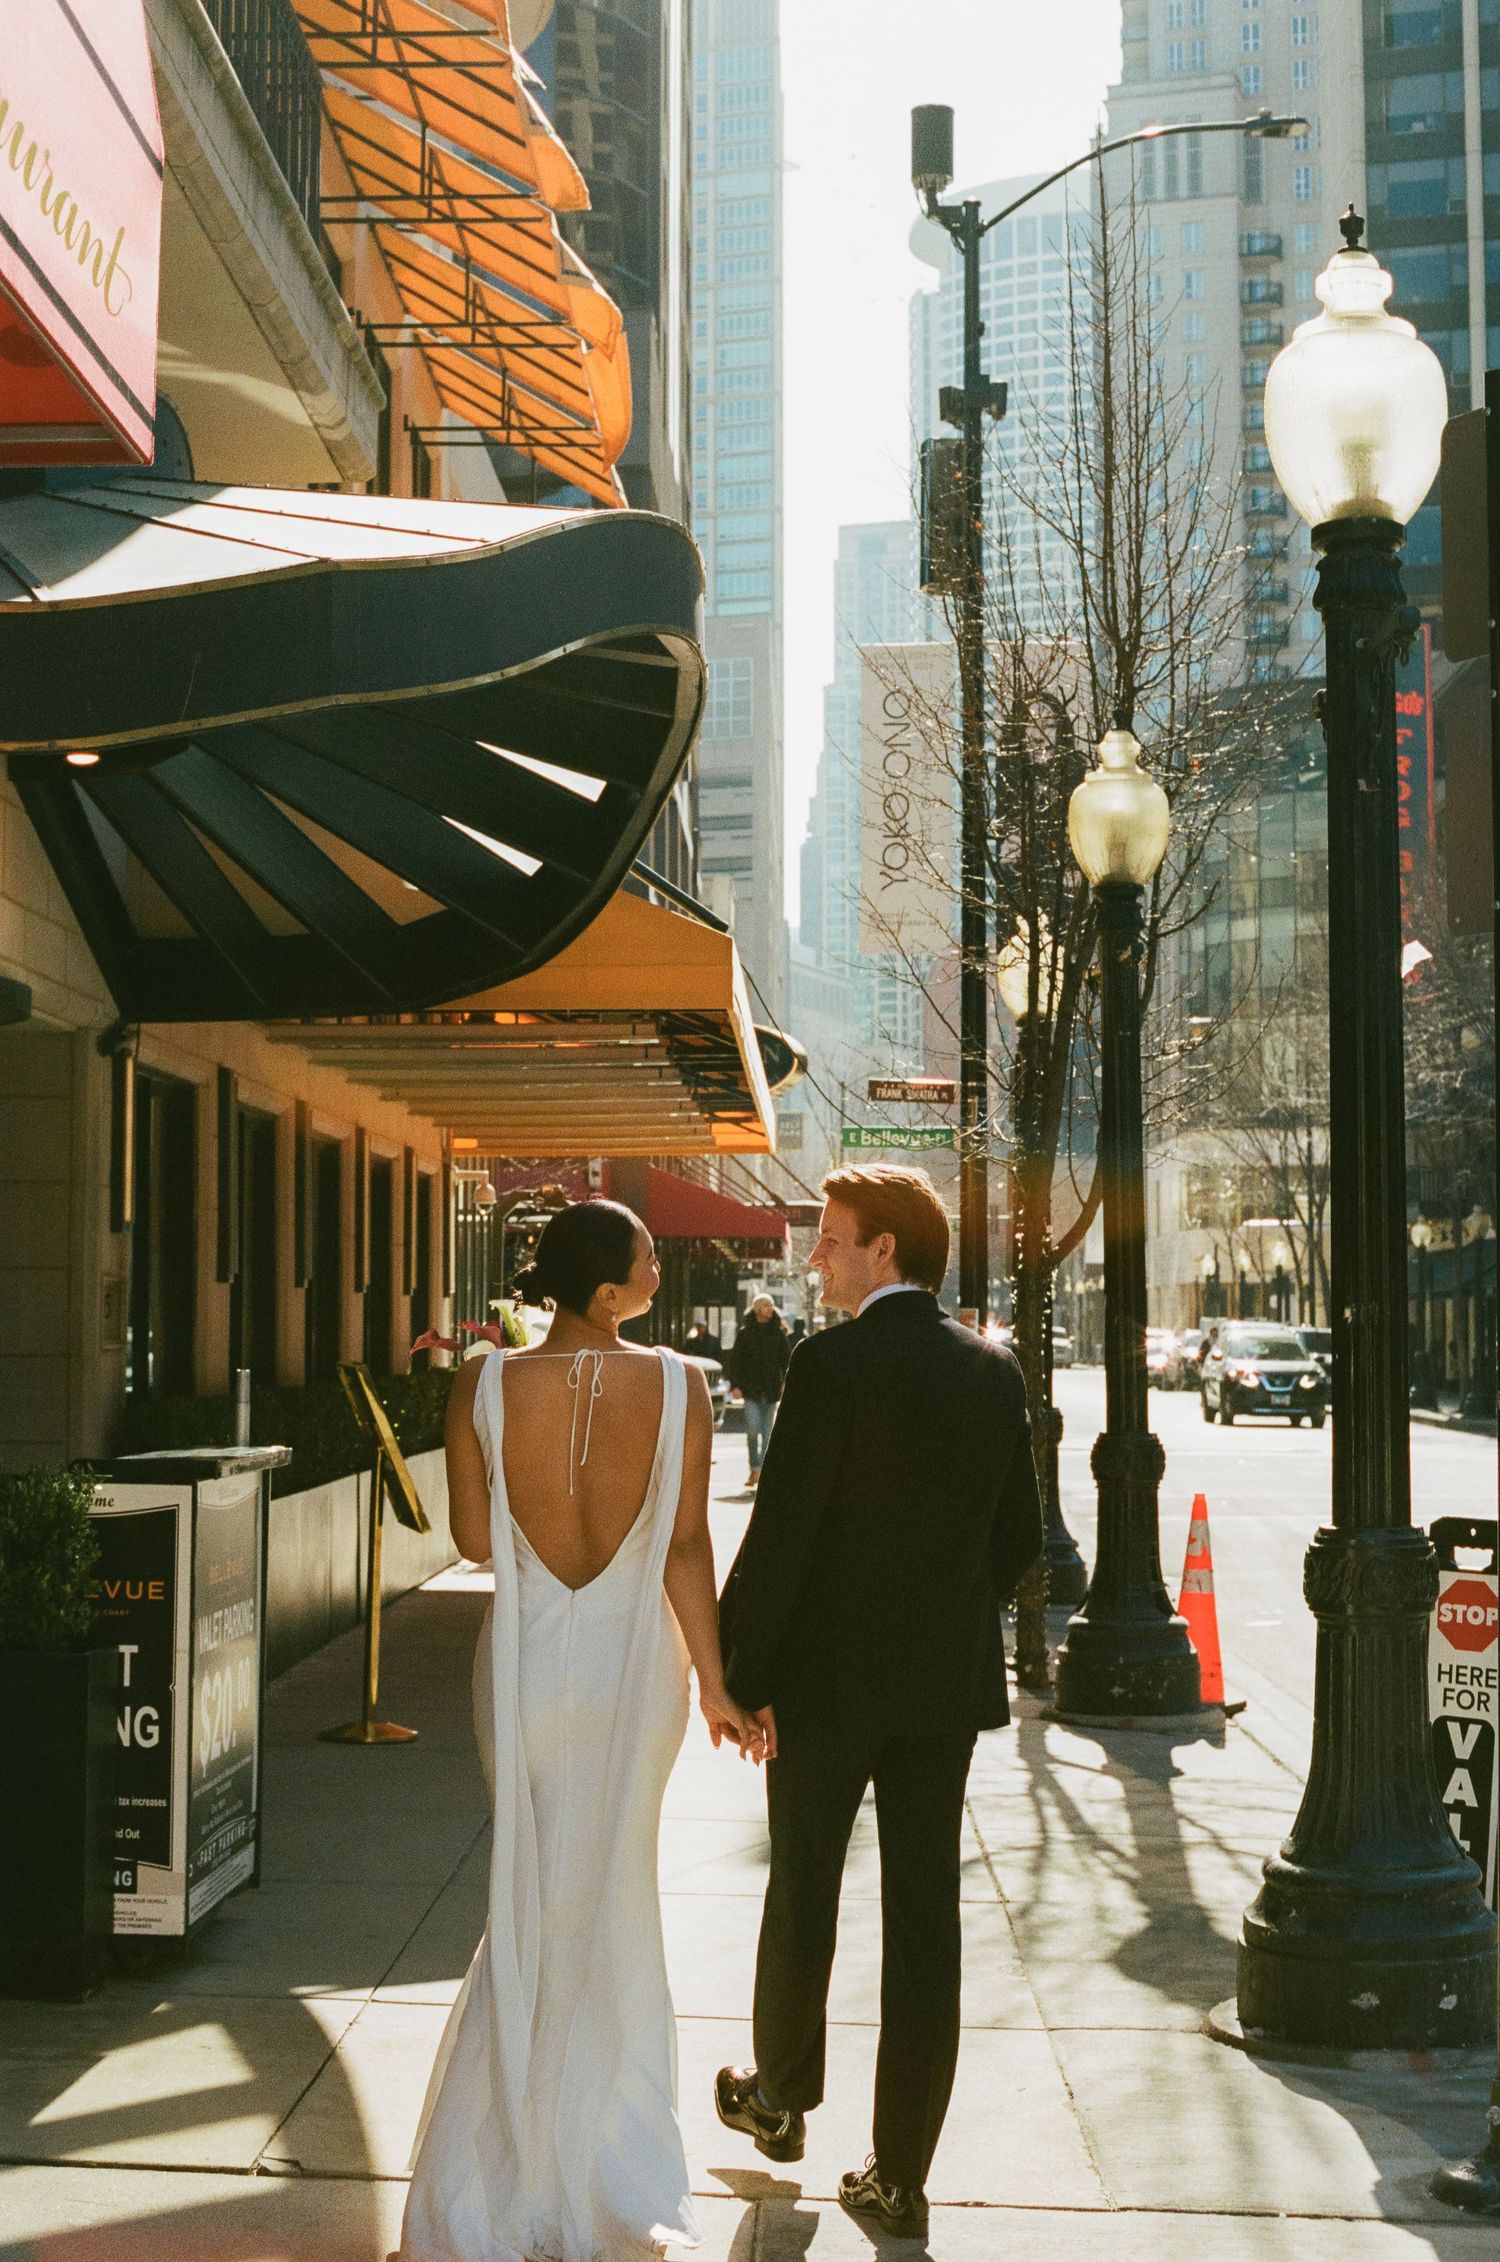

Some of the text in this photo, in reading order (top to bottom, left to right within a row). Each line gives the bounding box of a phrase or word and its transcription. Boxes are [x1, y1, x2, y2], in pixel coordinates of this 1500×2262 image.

[0, 99, 132, 316] urant
[882, 690, 911, 779] ONO
[880, 792, 910, 891] YOKO
[876, 1088, 902, 1100] FRANK
[906, 1088, 938, 1101] SINATRA
[849, 1132, 857, 1143] E
[861, 1130, 930, 1147] Bellevue
[223, 1598, 254, 1644] PARKING
[1438, 1602, 1498, 1627] STOP
[1437, 1662, 1498, 1689] HERE
[1442, 1687, 1491, 1713] FOR
[118, 1797, 167, 1807] tax increases
[125, 1828, 140, 1839] Out
